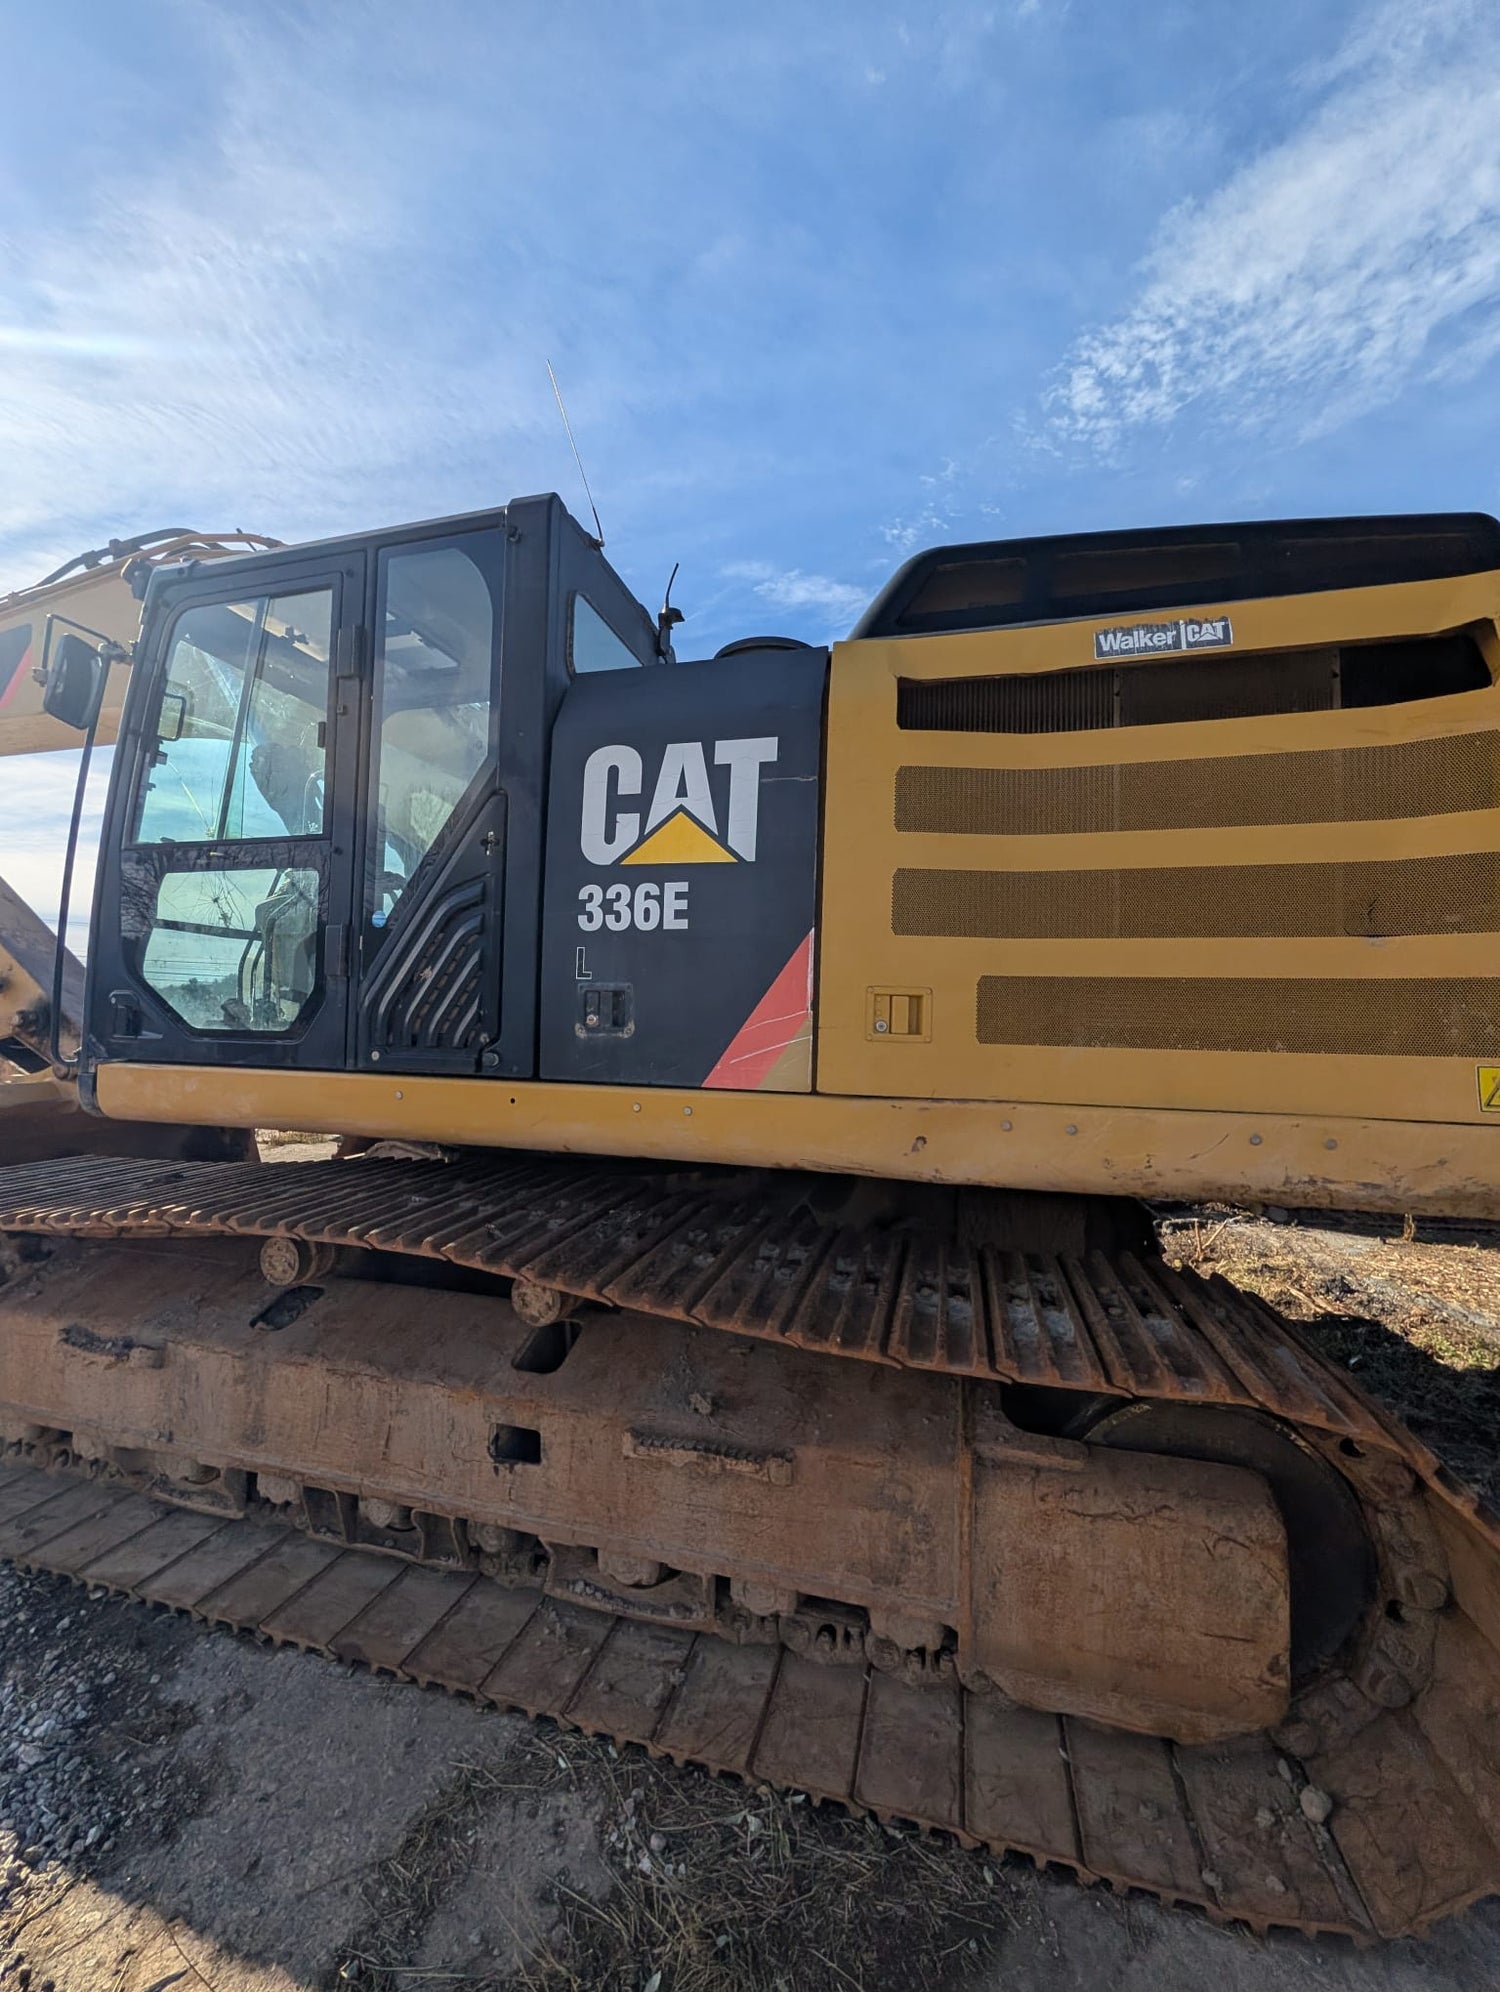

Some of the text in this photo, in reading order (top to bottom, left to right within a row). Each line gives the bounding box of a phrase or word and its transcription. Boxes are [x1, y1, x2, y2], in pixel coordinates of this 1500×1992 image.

[1098, 621, 1226, 652] Walker CAT
[580, 736, 778, 866] CAT
[577, 881, 690, 932] 336E
[575, 946, 593, 980] L
